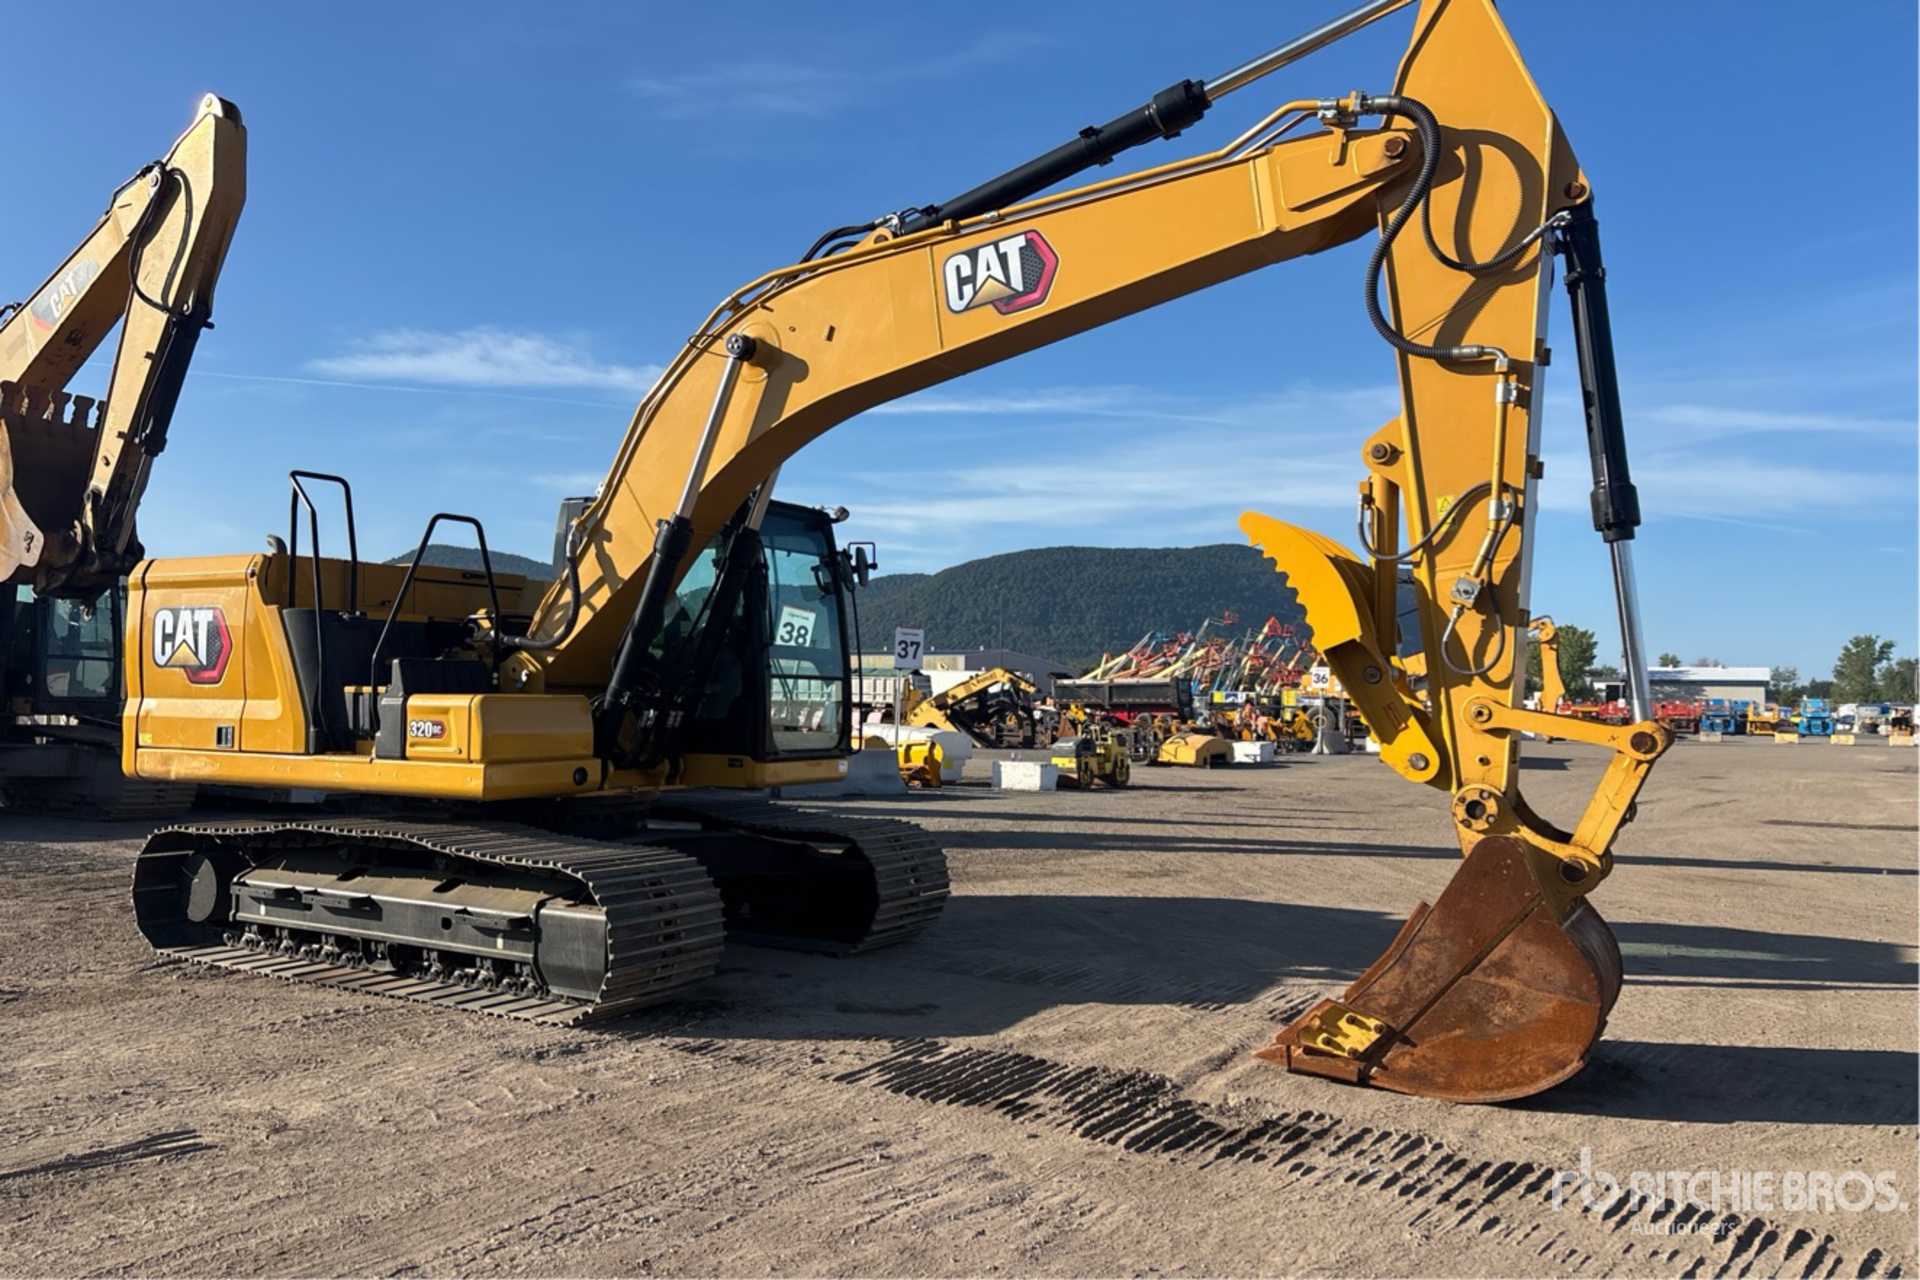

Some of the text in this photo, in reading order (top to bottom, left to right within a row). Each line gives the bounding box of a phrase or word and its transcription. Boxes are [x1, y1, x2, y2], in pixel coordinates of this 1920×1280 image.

[945, 234, 1027, 312] CAT
[50, 272, 78, 319] CAT
[154, 609, 214, 666] CAT
[780, 621, 809, 646] 38
[897, 639, 921, 660] 37
[1313, 673, 1328, 684] 36
[410, 720, 432, 737] 320
